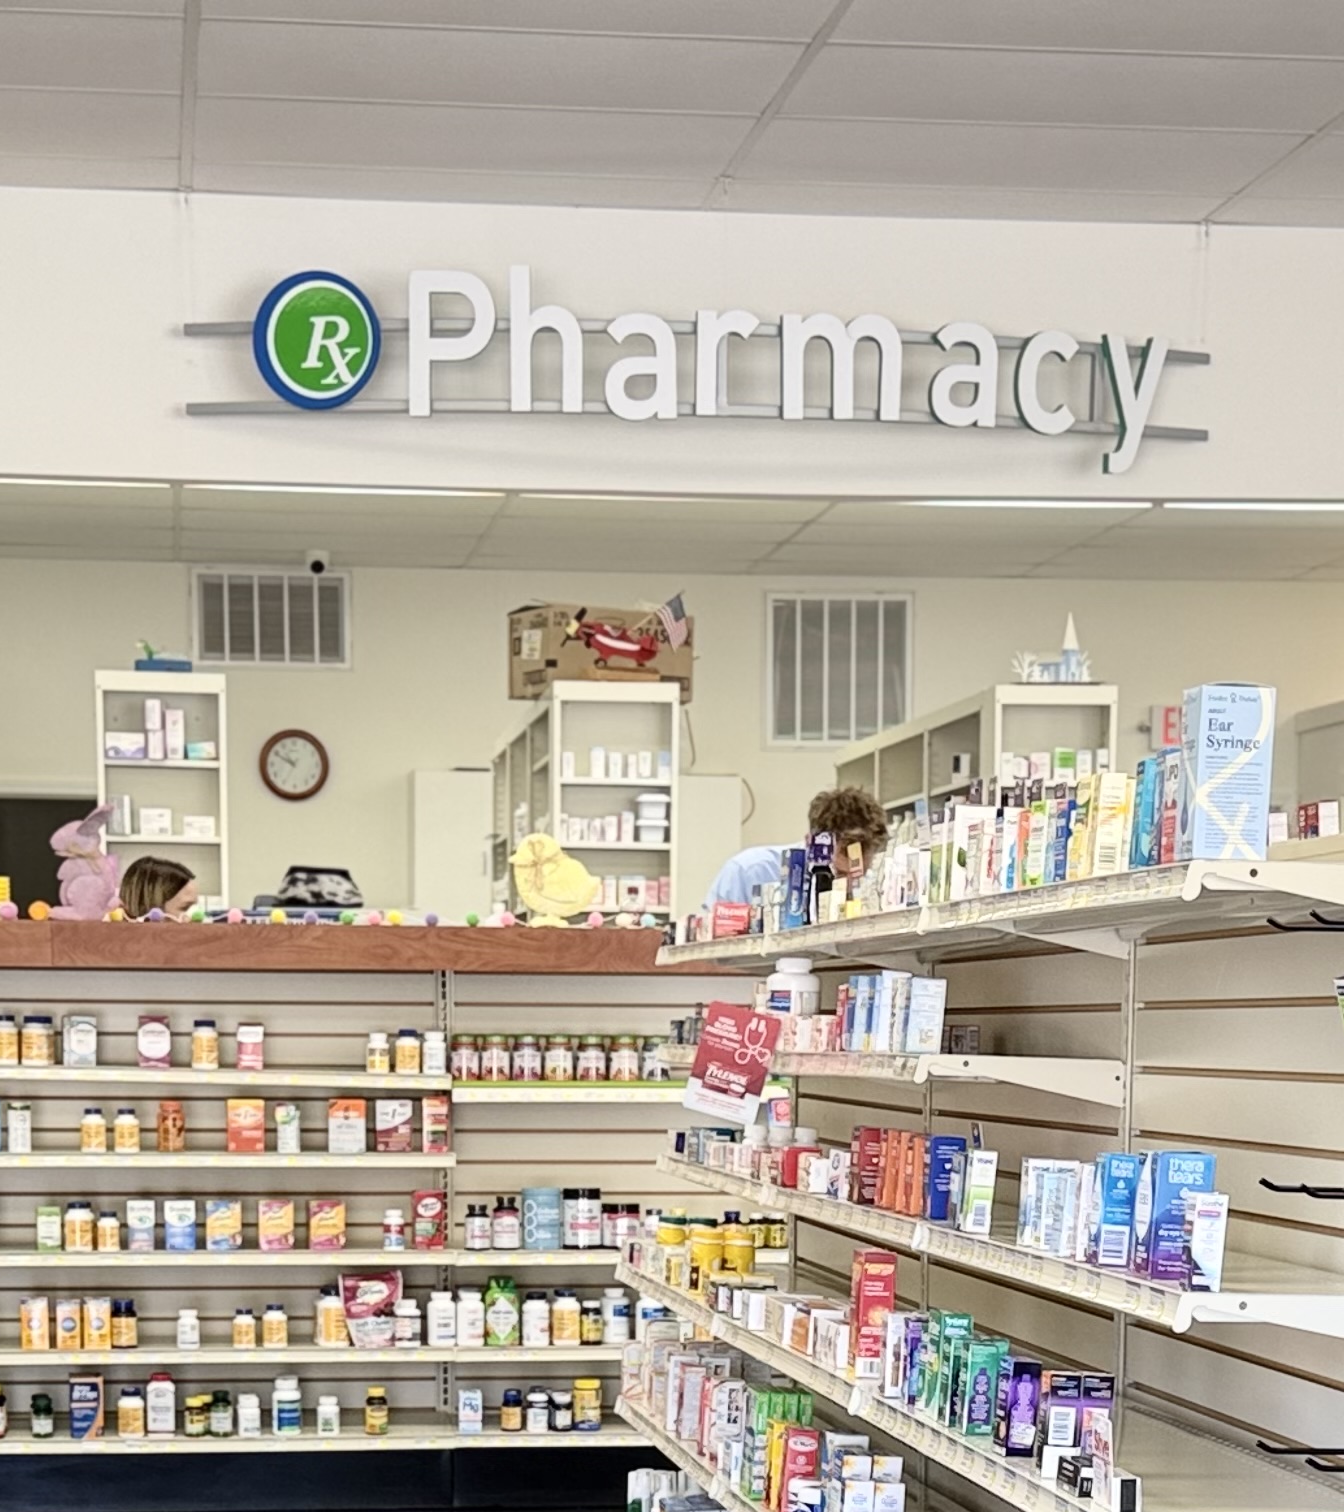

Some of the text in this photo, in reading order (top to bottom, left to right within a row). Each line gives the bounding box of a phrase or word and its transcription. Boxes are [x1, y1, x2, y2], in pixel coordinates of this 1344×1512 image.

[306, 264, 1167, 474] Rx Pharmacy
[1207, 718, 1234, 732] Ear
[1206, 735, 1260, 752] Syringe
[1169, 1157, 1205, 1172] thera
